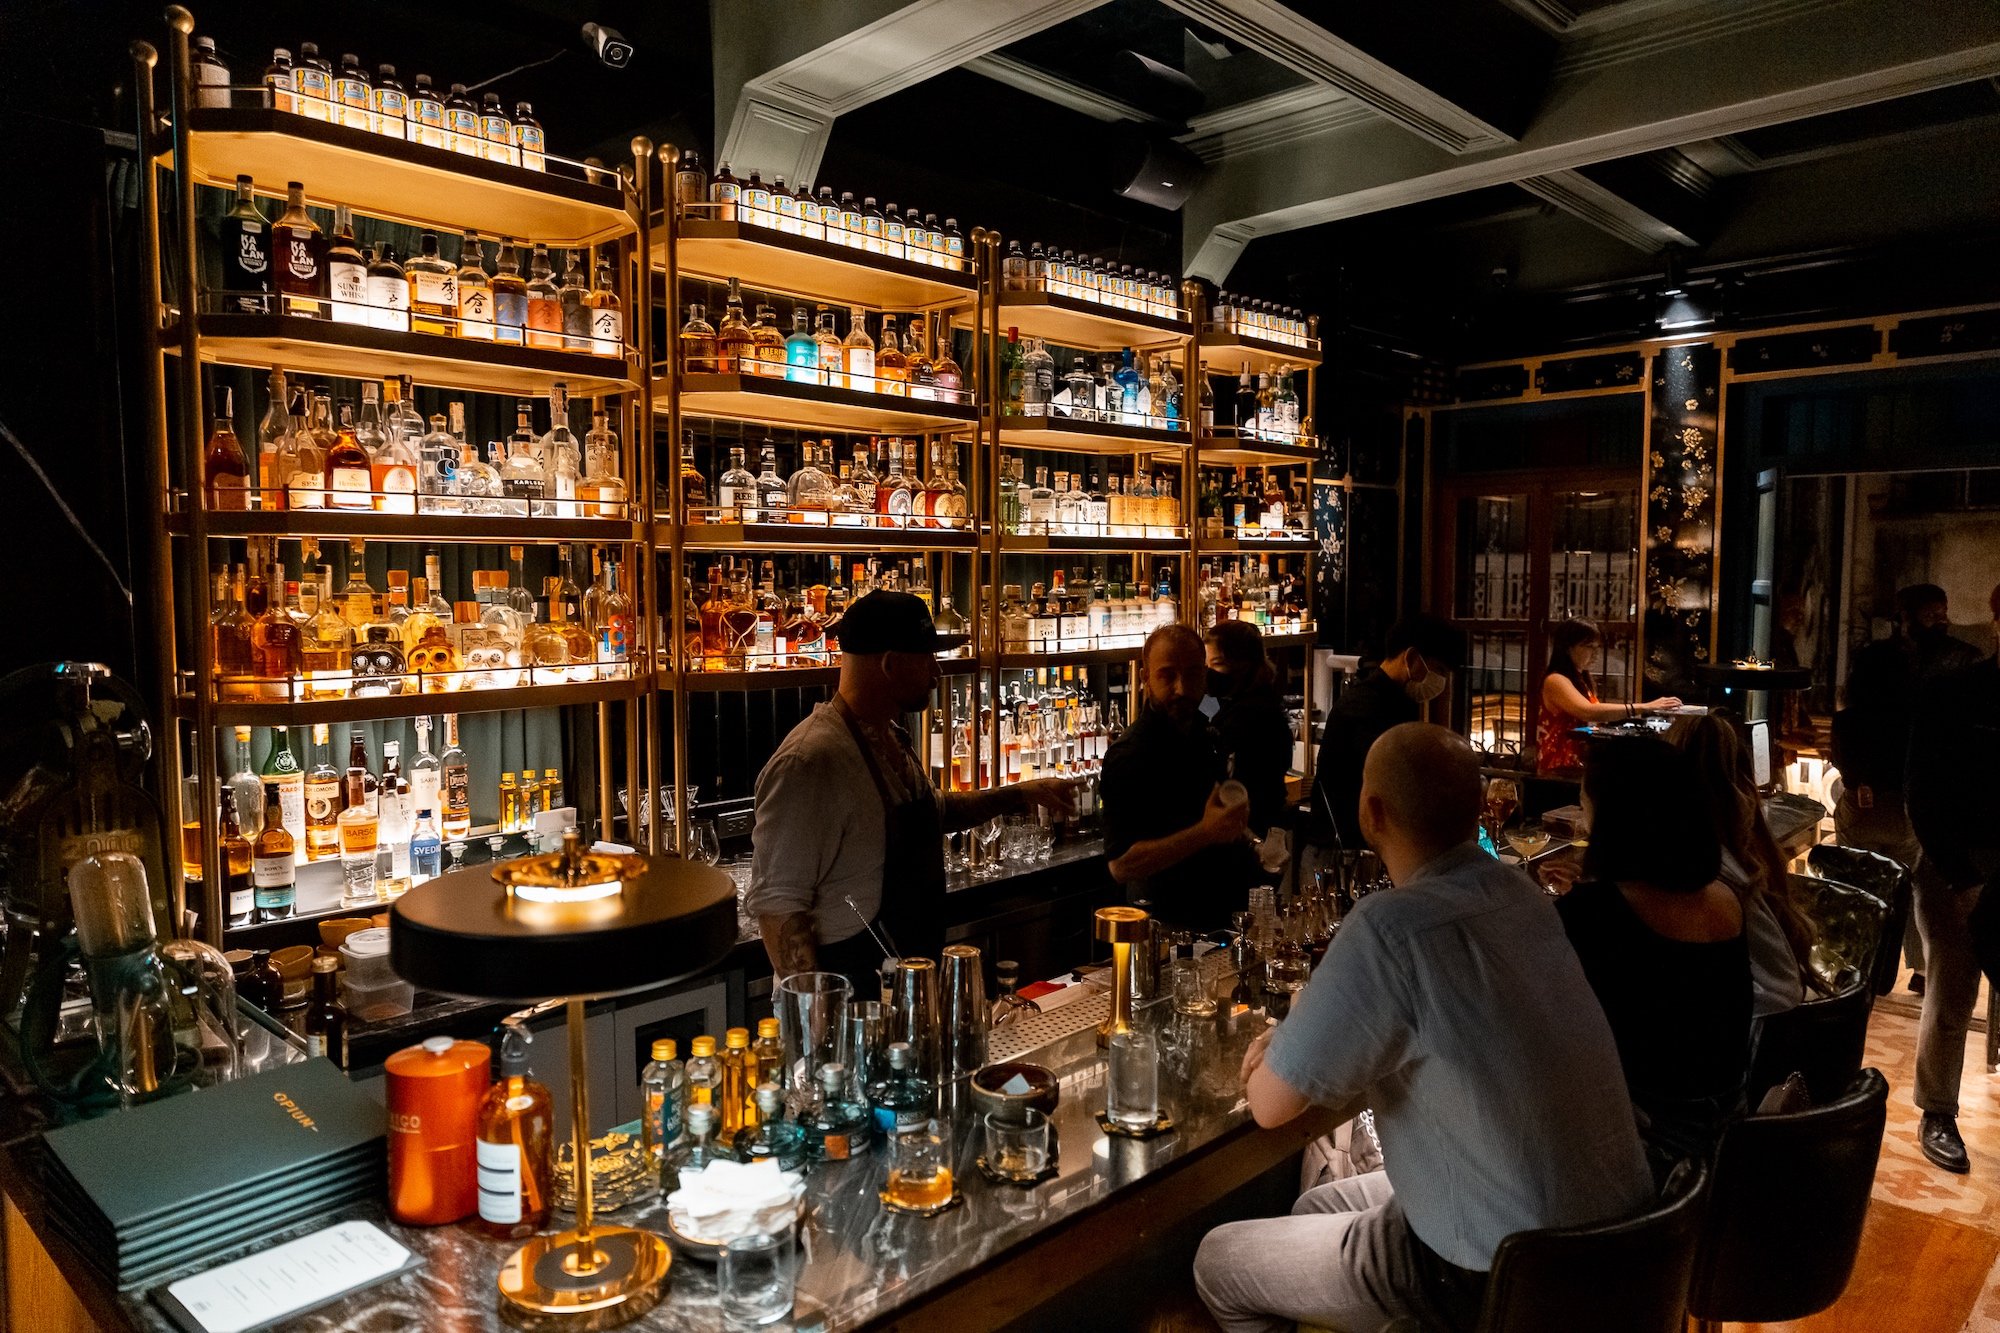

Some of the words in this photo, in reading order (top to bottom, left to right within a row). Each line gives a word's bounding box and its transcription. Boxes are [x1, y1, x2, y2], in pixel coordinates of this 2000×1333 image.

[241, 234, 257, 245] KA
[241, 249, 265, 261] LAN
[291, 255, 314, 267] LAN
